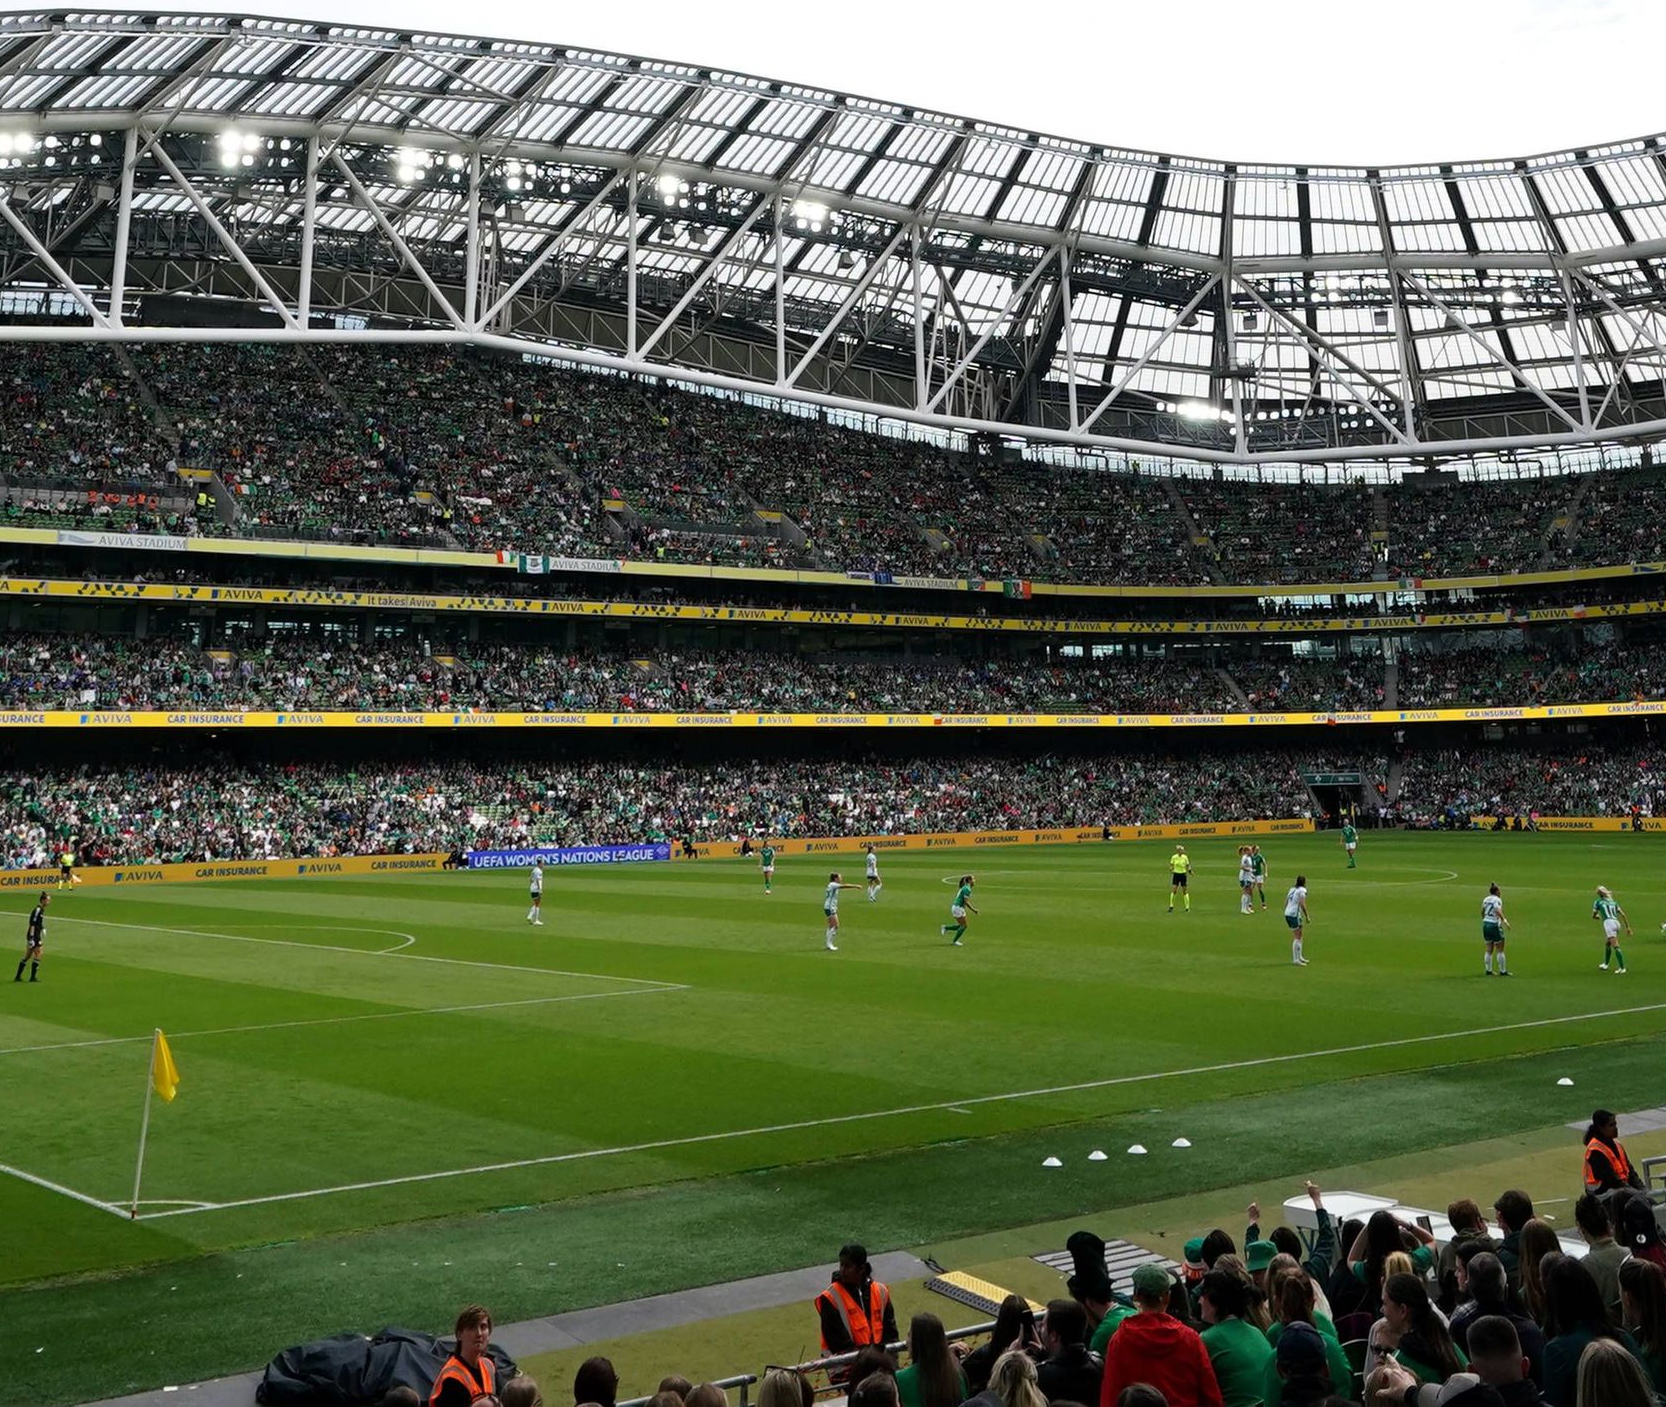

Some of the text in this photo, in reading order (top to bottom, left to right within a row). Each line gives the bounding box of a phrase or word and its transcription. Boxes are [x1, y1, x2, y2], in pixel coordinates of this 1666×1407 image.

[99, 536, 187, 549] AVIVA STADIUM
[552, 560, 620, 571] AVIVA STADIUM
[223, 590, 263, 600] AVIVA
[378, 595, 405, 606] takes
[409, 597, 437, 607] Aviva
[552, 603, 584, 612] AVIVA
[737, 610, 767, 619] AVIVA
[1535, 610, 1568, 619] AVIVA
[902, 617, 929, 625] AVIVA
[1373, 618, 1407, 626] AVIVA
[1073, 622, 1101, 630] AVIVA
[1215, 623, 1249, 631] AVIVA
[1557, 707, 1583, 715] AVIVA
[1608, 704, 1664, 713] CAR INSURANCE
[1409, 712, 1438, 720] AVIVA
[1465, 709, 1523, 718] CAR INSURANCE
[93, 714, 132, 724] AVIVA
[167, 714, 244, 724] CAR INSURANCE
[287, 714, 323, 724] AVIVA
[355, 715, 424, 724] CAR INSURANCE
[464, 715, 496, 724] AVIVA
[524, 716, 586, 724] CAR INSURANCE
[622, 716, 651, 724] AVIVA
[676, 716, 732, 724] CAR INSURANCE
[766, 716, 793, 724] AVIVA
[815, 716, 867, 724] CAR INSURANCE
[896, 716, 920, 724] AVIVA
[1015, 716, 1037, 724] AVIVA
[1056, 716, 1100, 724] CAR INSURANCE
[1126, 716, 1150, 724] AVIVA
[1170, 716, 1224, 724] CAR INSURANCE
[1258, 715, 1286, 723] AVIVA
[1312, 715, 1327, 723] CAR
[813, 843, 839, 852] AVIVA
[474, 849, 654, 867] UEFA WOMEN'S NATIONS LEAGUE
[308, 863, 342, 873] AVIVA
[371, 859, 436, 871] CAR INSURANCE
[125, 871, 163, 882] AVIVA
[195, 866, 267, 878] CAR INSURANCE
[0, 877, 21, 887] CAR
[1604, 903, 1618, 920] 10
